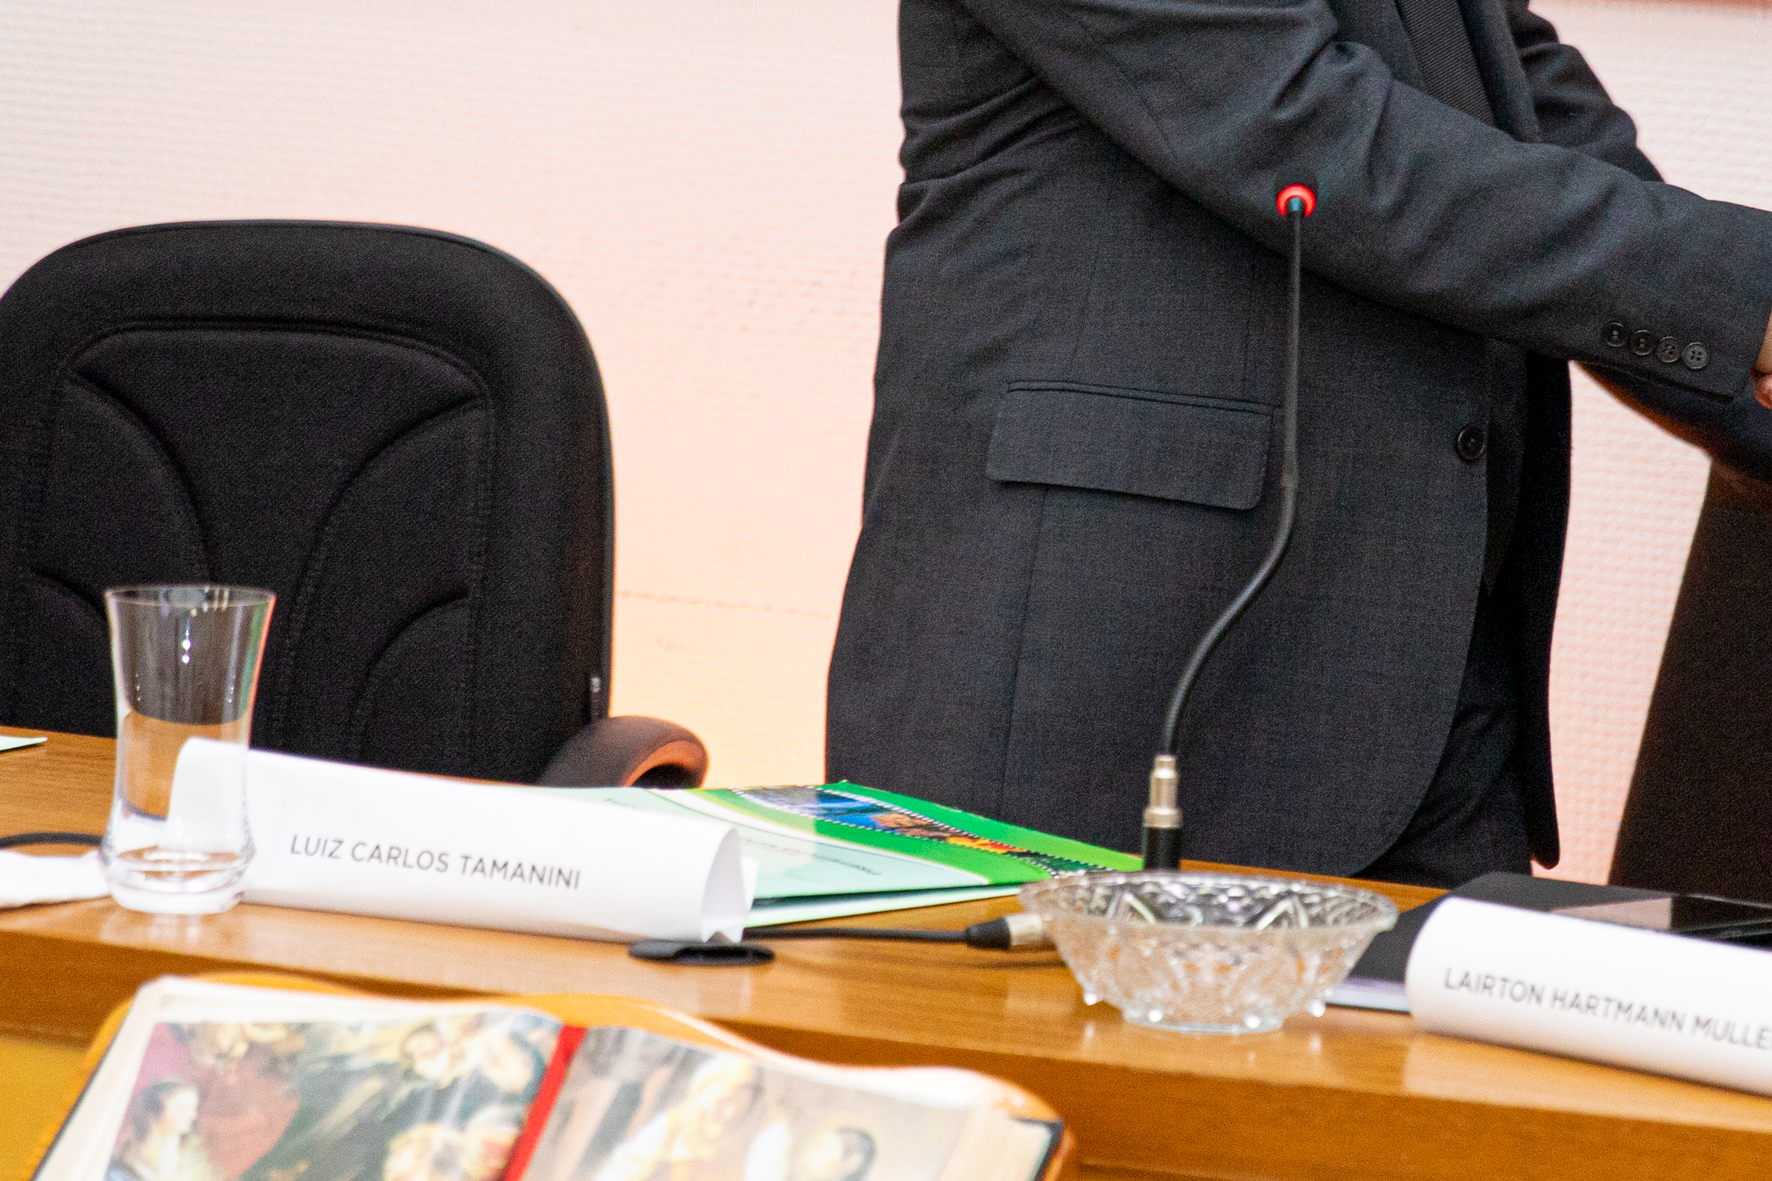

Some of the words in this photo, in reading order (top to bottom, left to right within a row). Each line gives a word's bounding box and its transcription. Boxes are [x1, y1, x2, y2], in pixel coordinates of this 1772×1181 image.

[290, 834, 345, 860] LUIZ
[350, 841, 449, 873] CARLOS
[459, 854, 582, 891] TAMANINI
[1444, 968, 1545, 1008] LAIRTON
[1550, 988, 1686, 1033] HARTMANN
